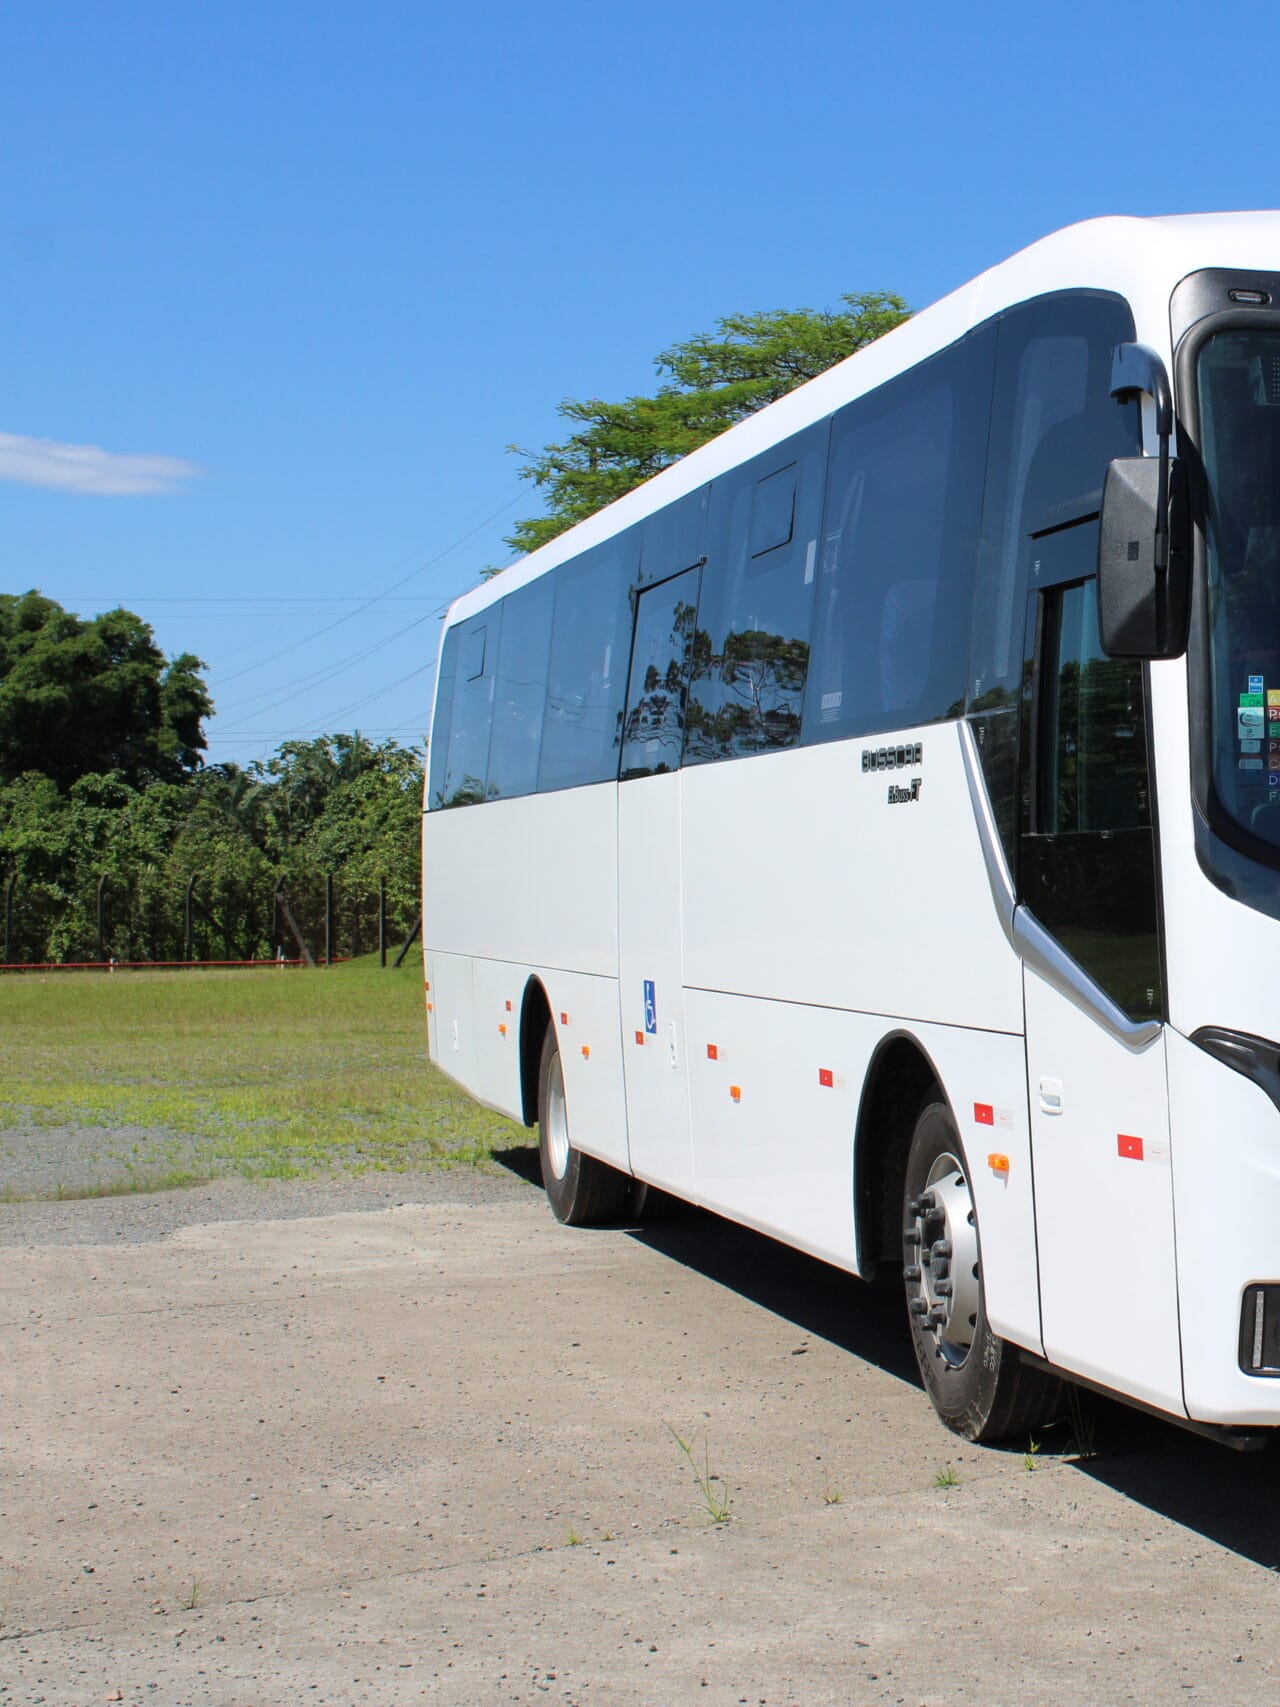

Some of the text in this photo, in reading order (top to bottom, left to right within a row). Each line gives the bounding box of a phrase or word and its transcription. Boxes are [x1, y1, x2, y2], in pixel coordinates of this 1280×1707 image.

[1269, 709, 1278, 720] P
[1270, 742, 1277, 752] P
[862, 742, 922, 773] BUSSCAR
[1270, 759, 1278, 769] C
[1269, 775, 1278, 785] D
[1270, 791, 1277, 801] F
